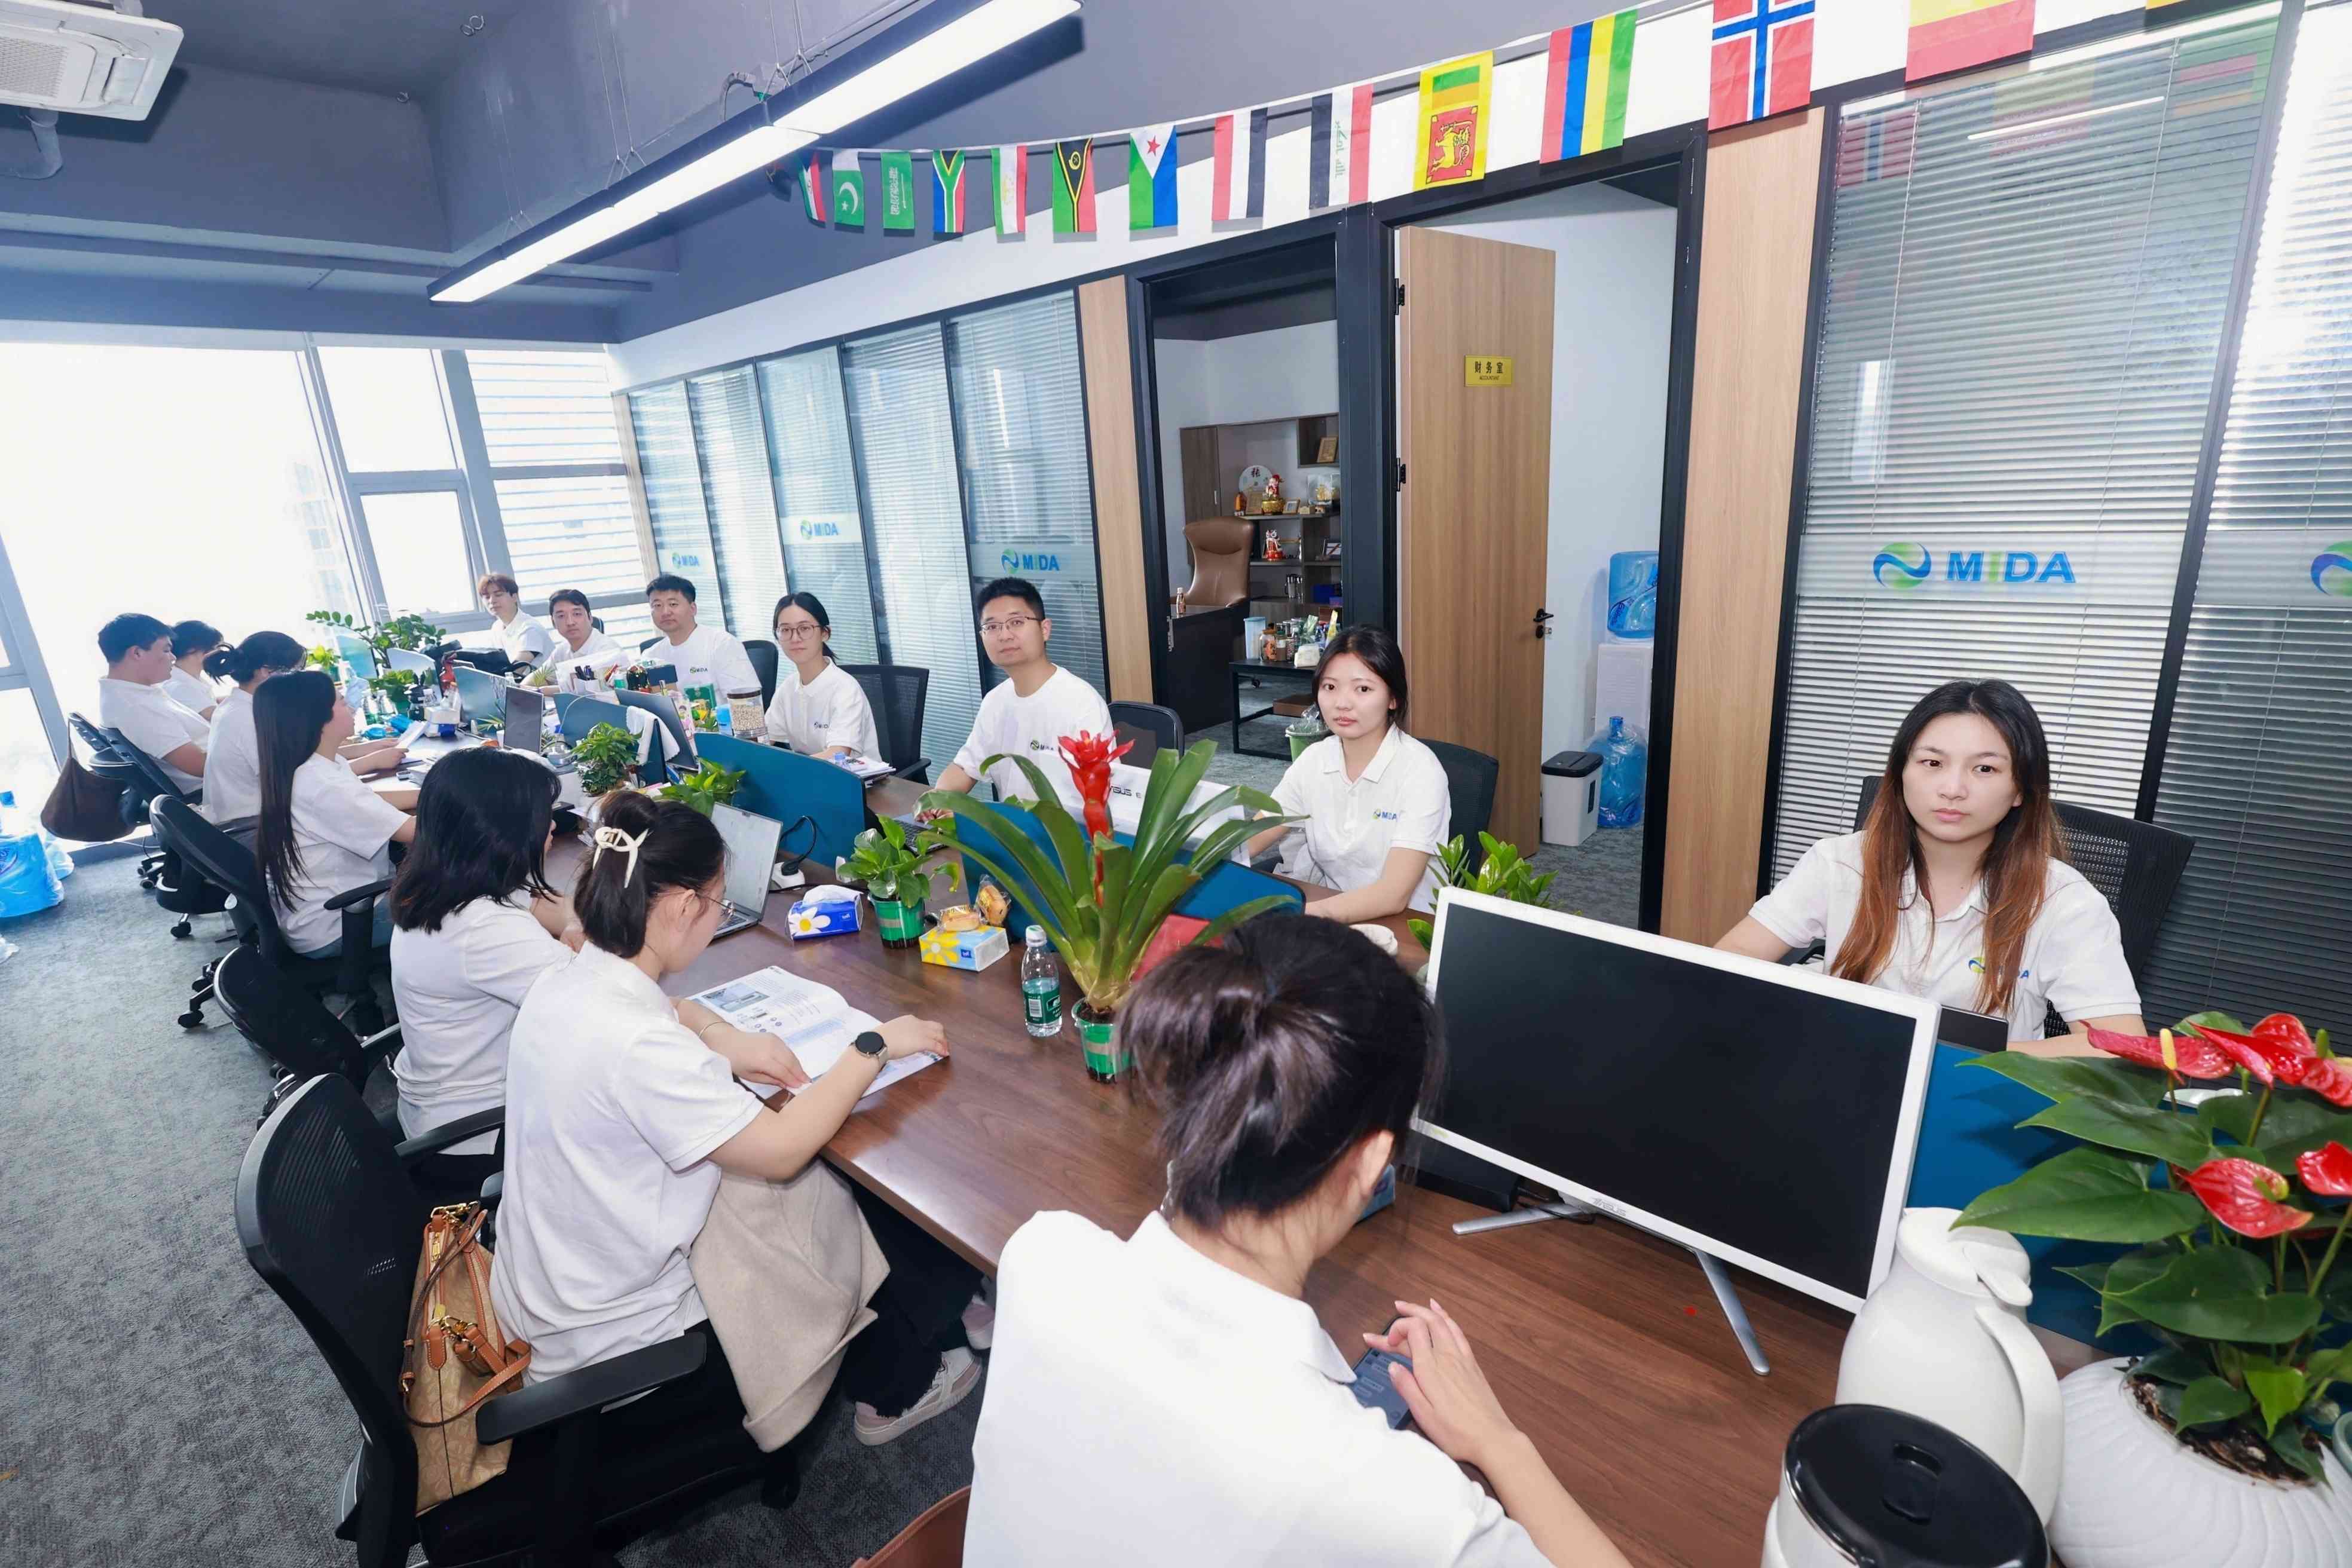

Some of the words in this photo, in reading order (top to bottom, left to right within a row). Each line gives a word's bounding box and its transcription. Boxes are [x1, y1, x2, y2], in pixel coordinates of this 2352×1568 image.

[1475, 361, 1503, 373] 财务室
[1023, 554, 1060, 571] MIDA
[1945, 550, 2076, 583] MIDA
